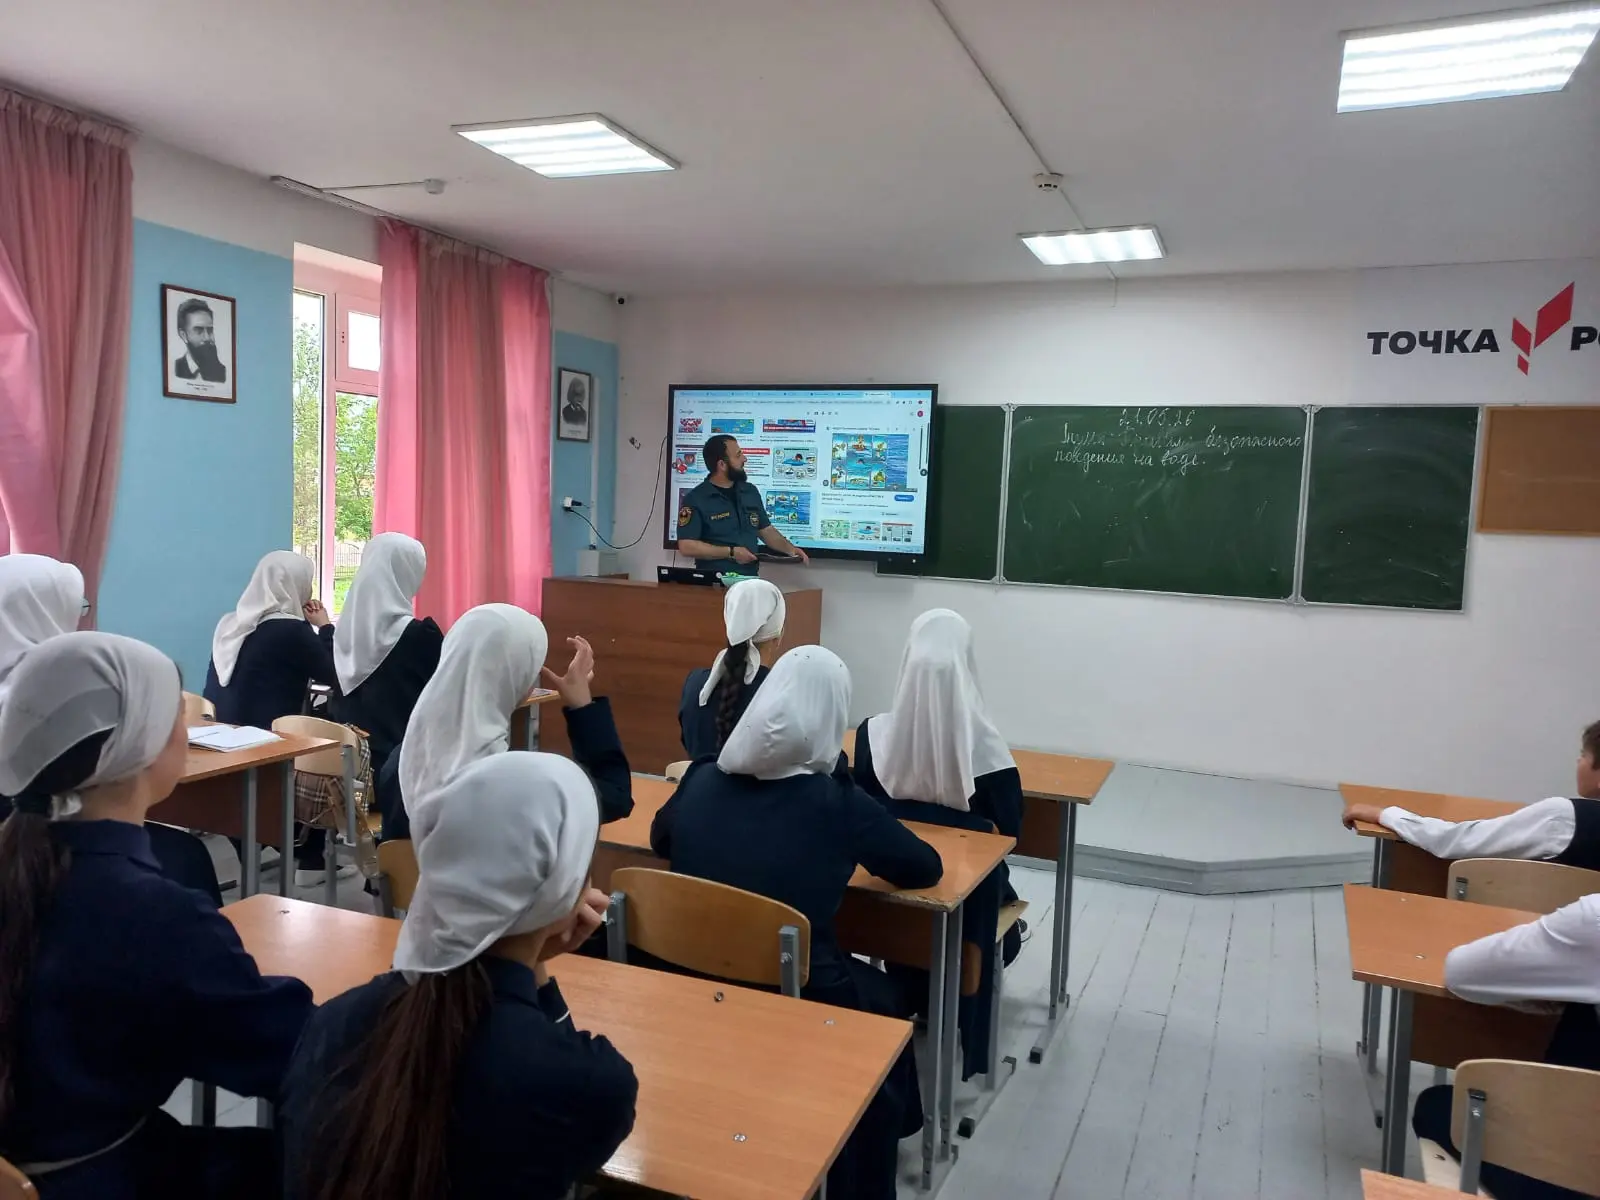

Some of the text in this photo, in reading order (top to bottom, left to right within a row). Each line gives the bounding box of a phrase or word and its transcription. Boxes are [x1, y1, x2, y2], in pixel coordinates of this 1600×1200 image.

[1367, 326, 1600, 355] ТОЧКА Р
[1133, 452, 1154, 467] на
